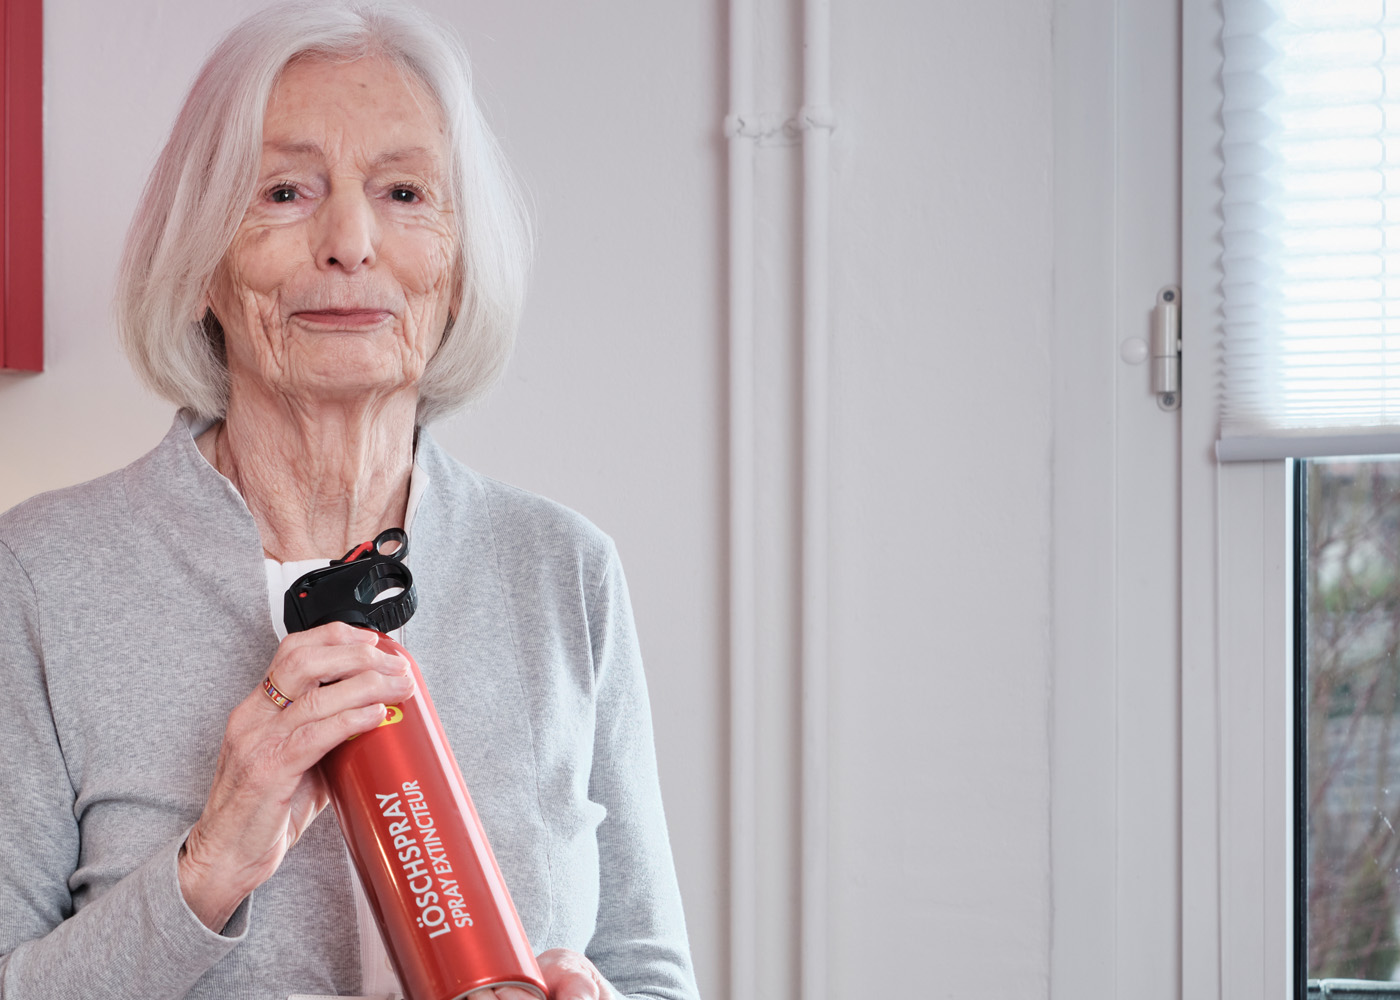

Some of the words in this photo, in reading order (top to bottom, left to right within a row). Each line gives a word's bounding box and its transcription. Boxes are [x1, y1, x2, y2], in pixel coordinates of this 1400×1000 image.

[375, 793, 451, 939] LÖSCHSPRAY
[402, 780, 453, 875] EXTINCTEUR
[438, 877, 473, 928] SPRAY
